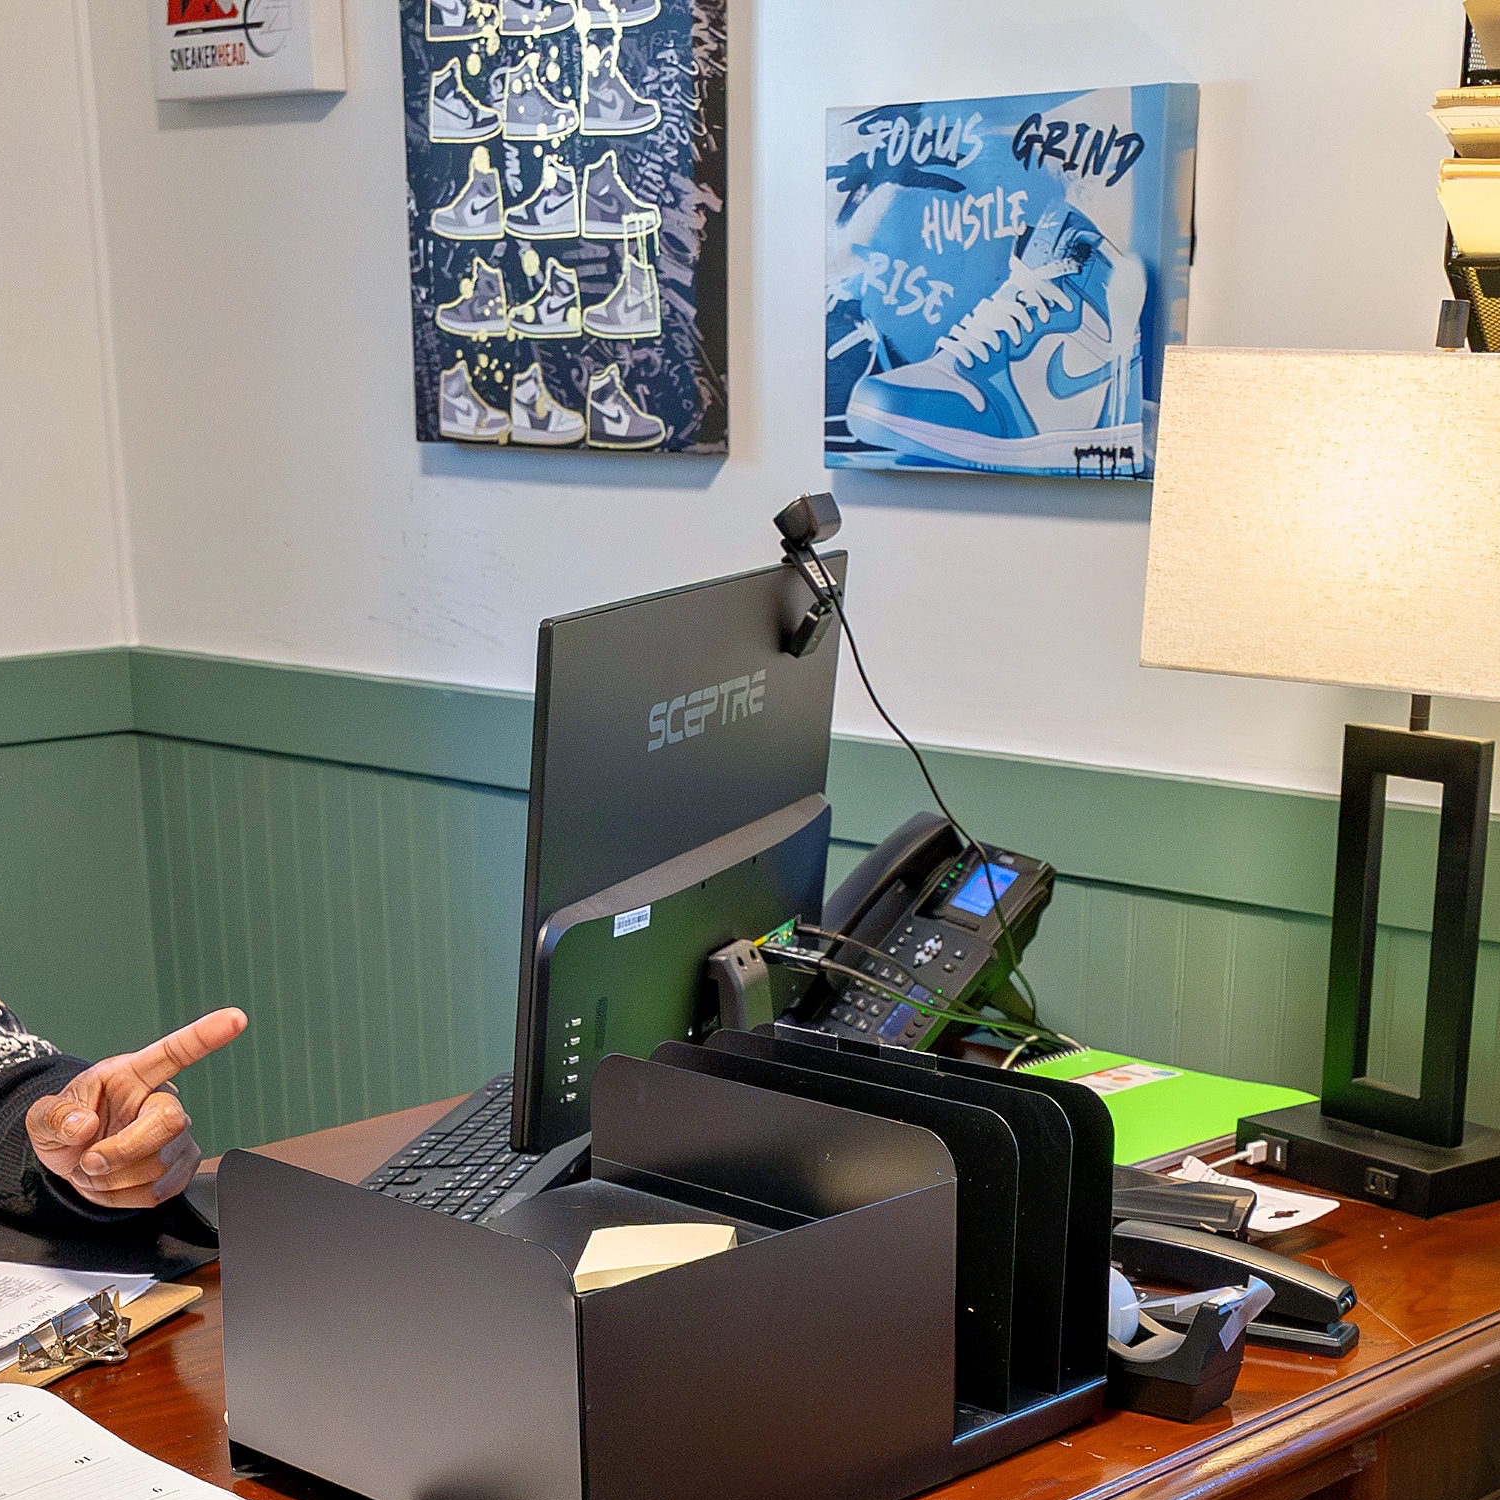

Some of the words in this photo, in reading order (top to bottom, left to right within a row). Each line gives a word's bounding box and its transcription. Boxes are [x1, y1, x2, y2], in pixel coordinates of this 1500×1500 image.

[864, 112, 983, 170] FOCUS
[1012, 112, 1145, 187] GRIND
[921, 185, 1029, 254] HUSTLE
[861, 251, 954, 325] RISE
[647, 668, 767, 752] SCEPTRE
[5, 1411, 25, 1424] 23
[74, 1456, 93, 1465] 16
